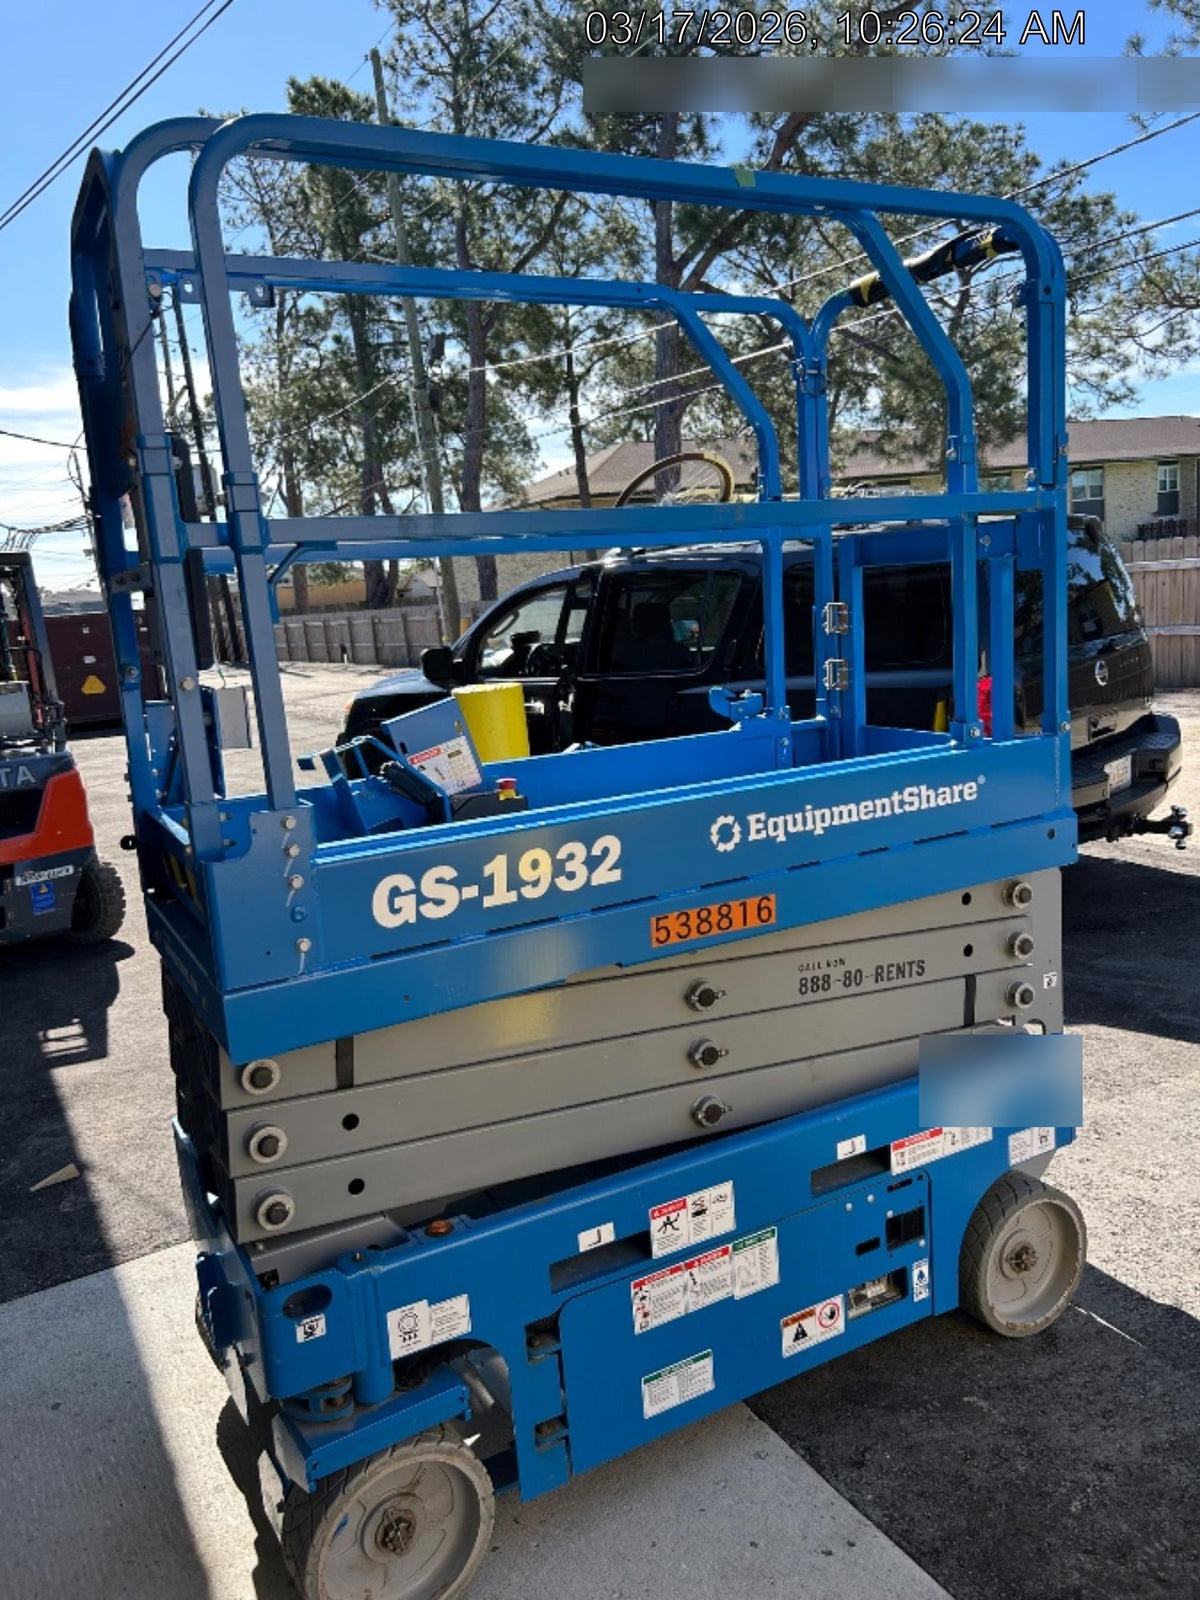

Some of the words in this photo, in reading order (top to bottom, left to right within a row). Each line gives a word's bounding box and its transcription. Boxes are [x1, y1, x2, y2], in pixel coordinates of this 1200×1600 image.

[372, 835, 622, 929] GS-1932
[655, 895, 772, 944] 538816
[798, 961, 822, 972] CALL
[798, 959, 926, 995] 888-80-RENTS
